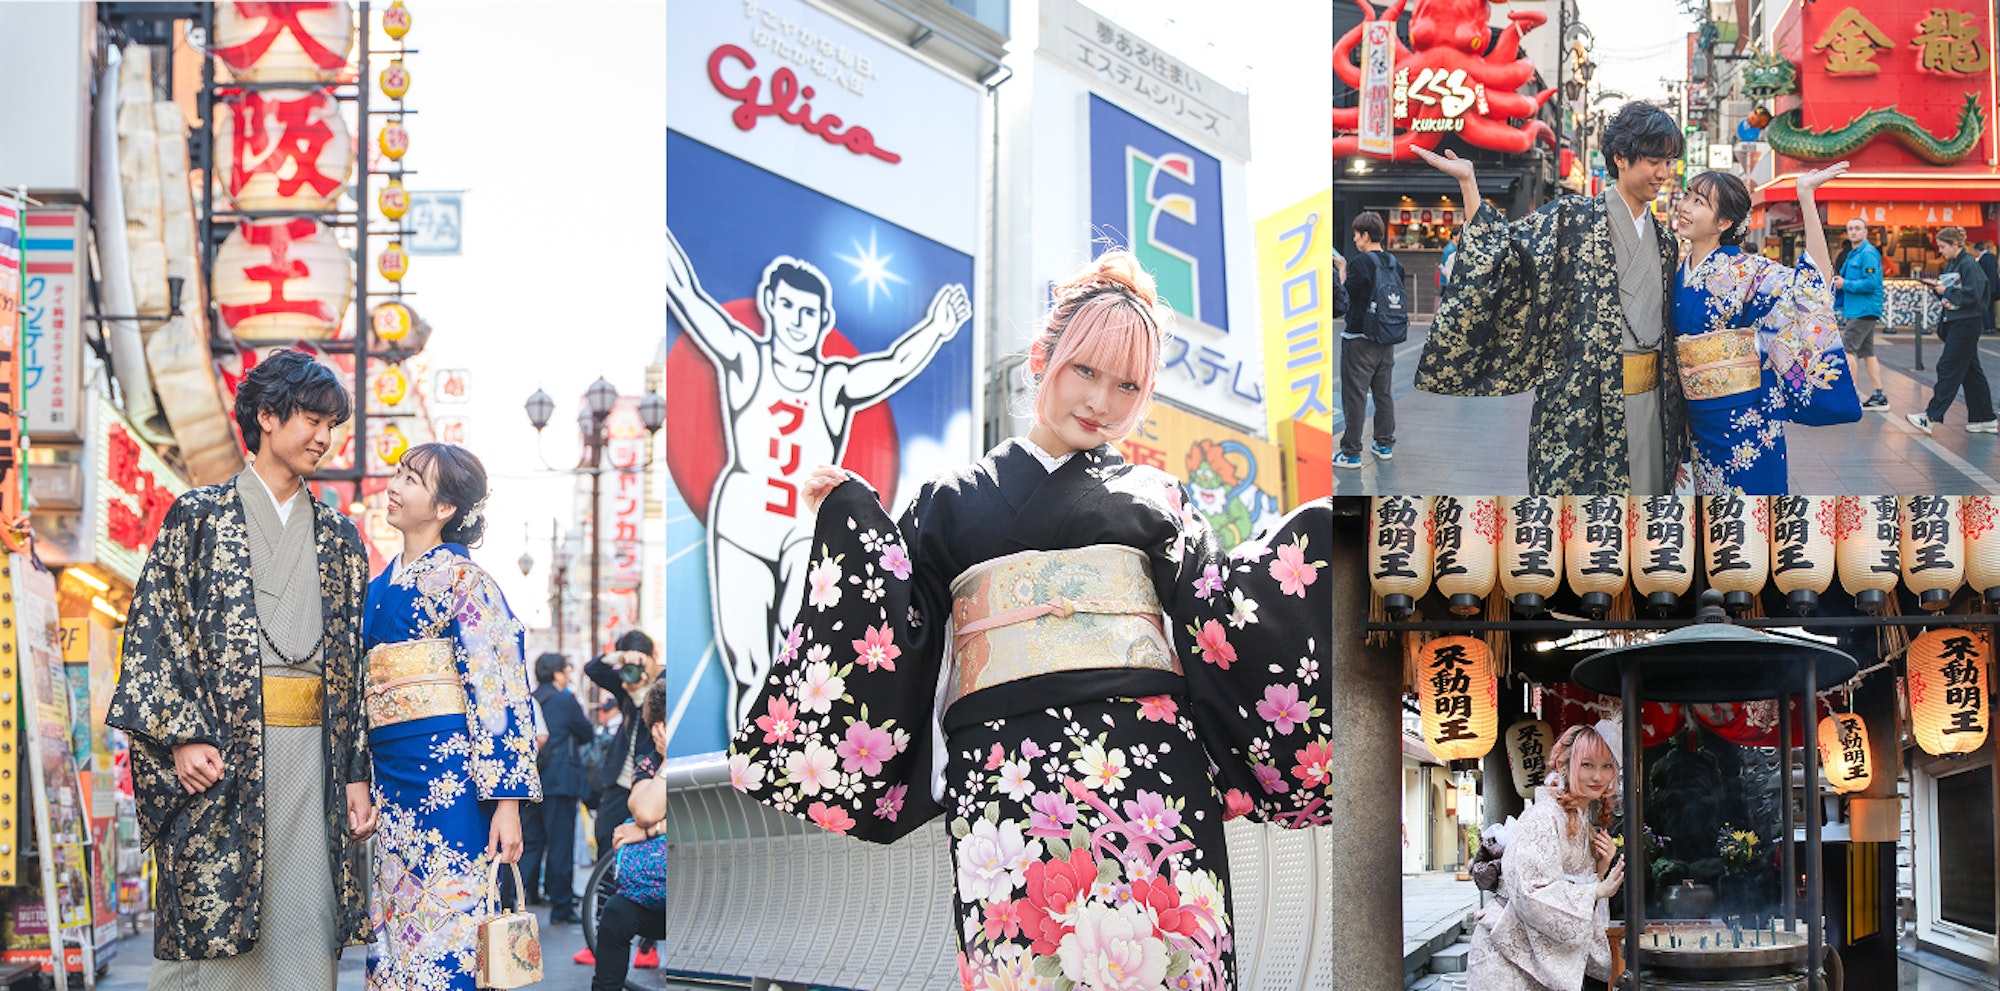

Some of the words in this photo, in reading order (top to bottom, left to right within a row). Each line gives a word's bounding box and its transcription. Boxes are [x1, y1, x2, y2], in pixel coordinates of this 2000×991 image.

[707, 44, 902, 165] Glico
[1096, 20, 1202, 93] 夢ある住まい
[1407, 67, 1476, 119] くくる
[1411, 117, 1465, 133] KUKURU
[1278, 213, 1329, 420] プロミス
[765, 398, 808, 519] グリコ
